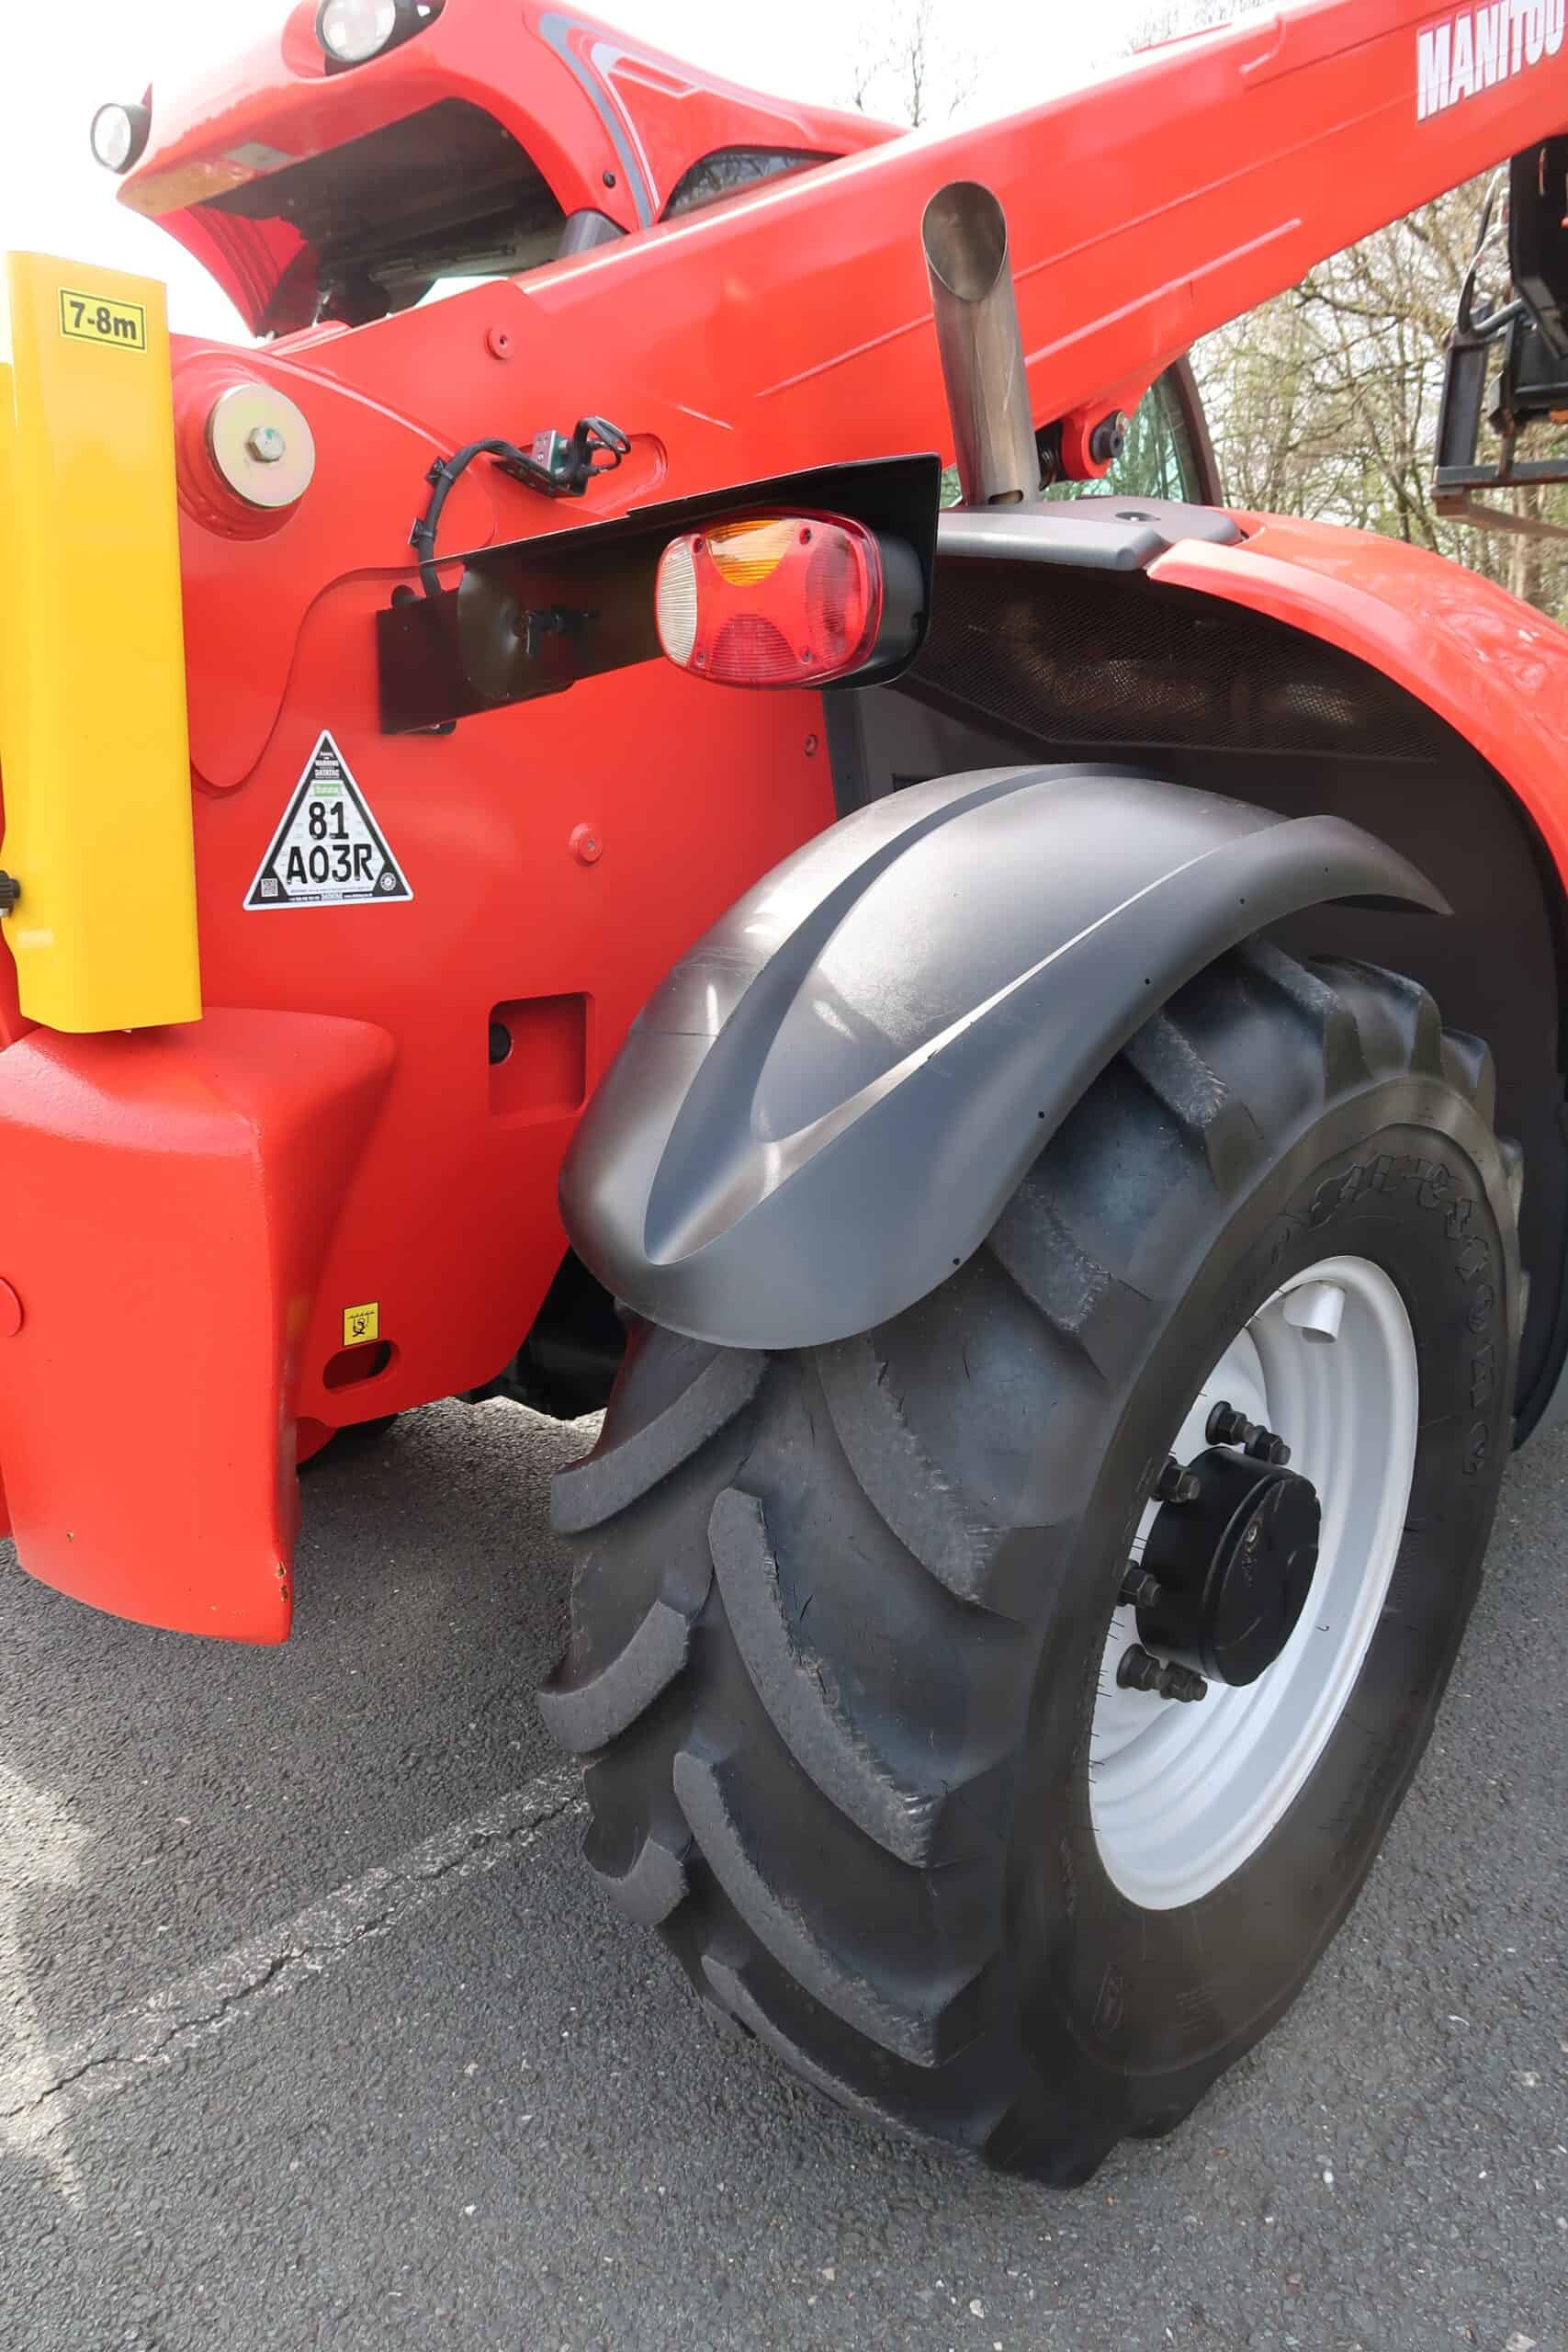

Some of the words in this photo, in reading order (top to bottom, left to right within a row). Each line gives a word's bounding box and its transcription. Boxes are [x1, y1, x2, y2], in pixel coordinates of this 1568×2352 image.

[1417, 0, 1565, 122] MANITOU
[70, 300, 136, 340] 7-8m
[309, 801, 349, 840] 81
